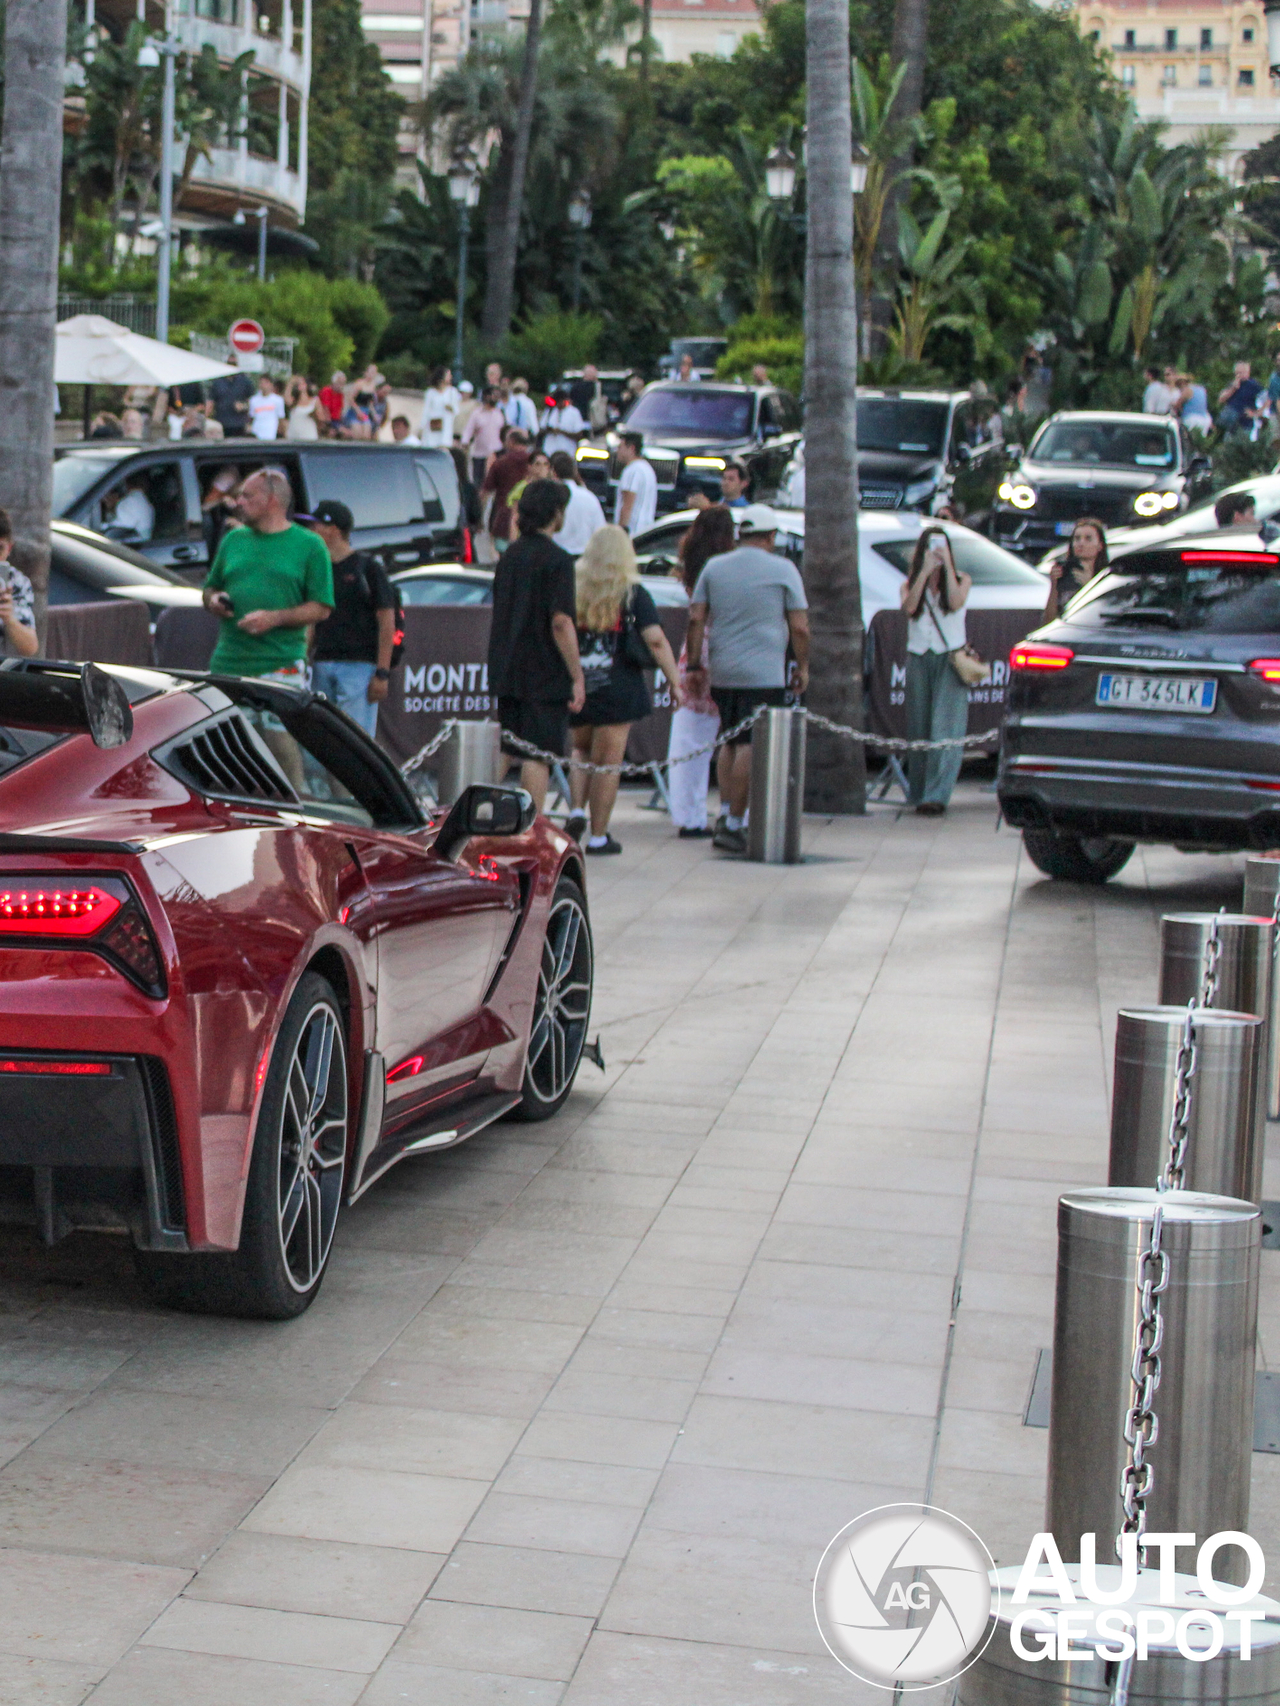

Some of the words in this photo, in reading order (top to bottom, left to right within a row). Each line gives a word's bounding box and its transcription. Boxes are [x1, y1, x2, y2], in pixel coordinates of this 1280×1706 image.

[404, 693, 460, 713] SOCIÉTÉ
[464, 696, 491, 712] DES
[1111, 678, 1133, 699] GT
[1140, 679, 1200, 706] 345LK
